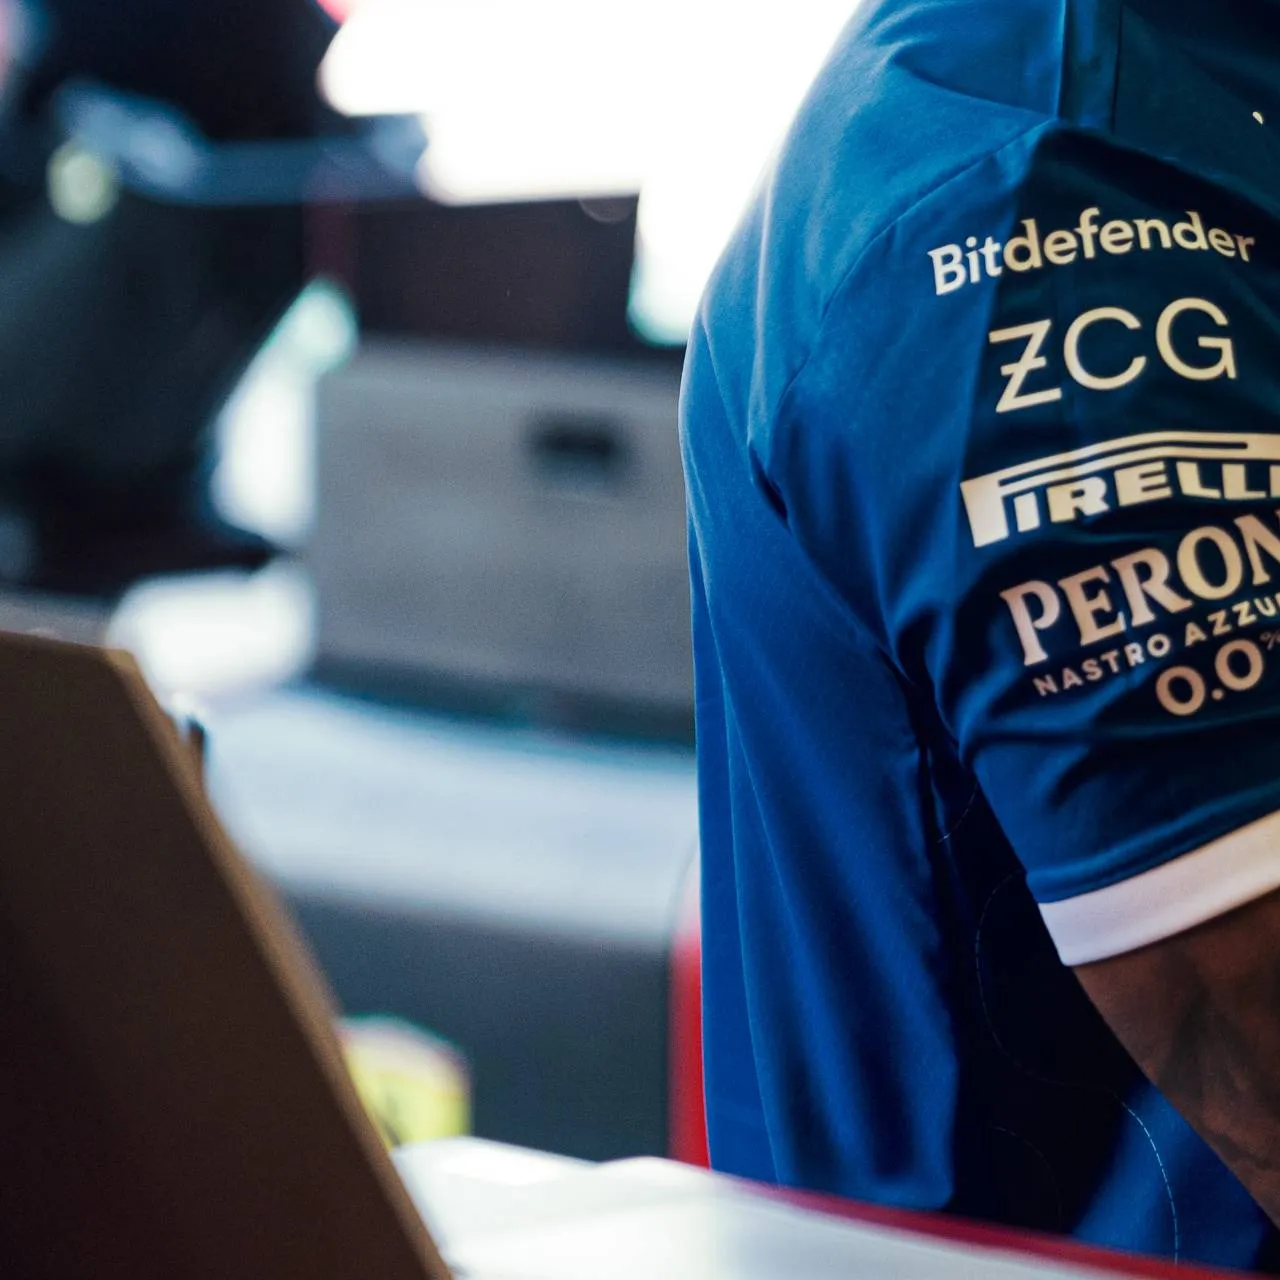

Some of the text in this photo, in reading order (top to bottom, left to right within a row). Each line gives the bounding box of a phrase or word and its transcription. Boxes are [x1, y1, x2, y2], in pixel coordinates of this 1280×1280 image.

[927, 207, 1256, 296] Bitdefender
[988, 296, 1238, 414] ZCG
[1032, 632, 1172, 697] NASTRO
